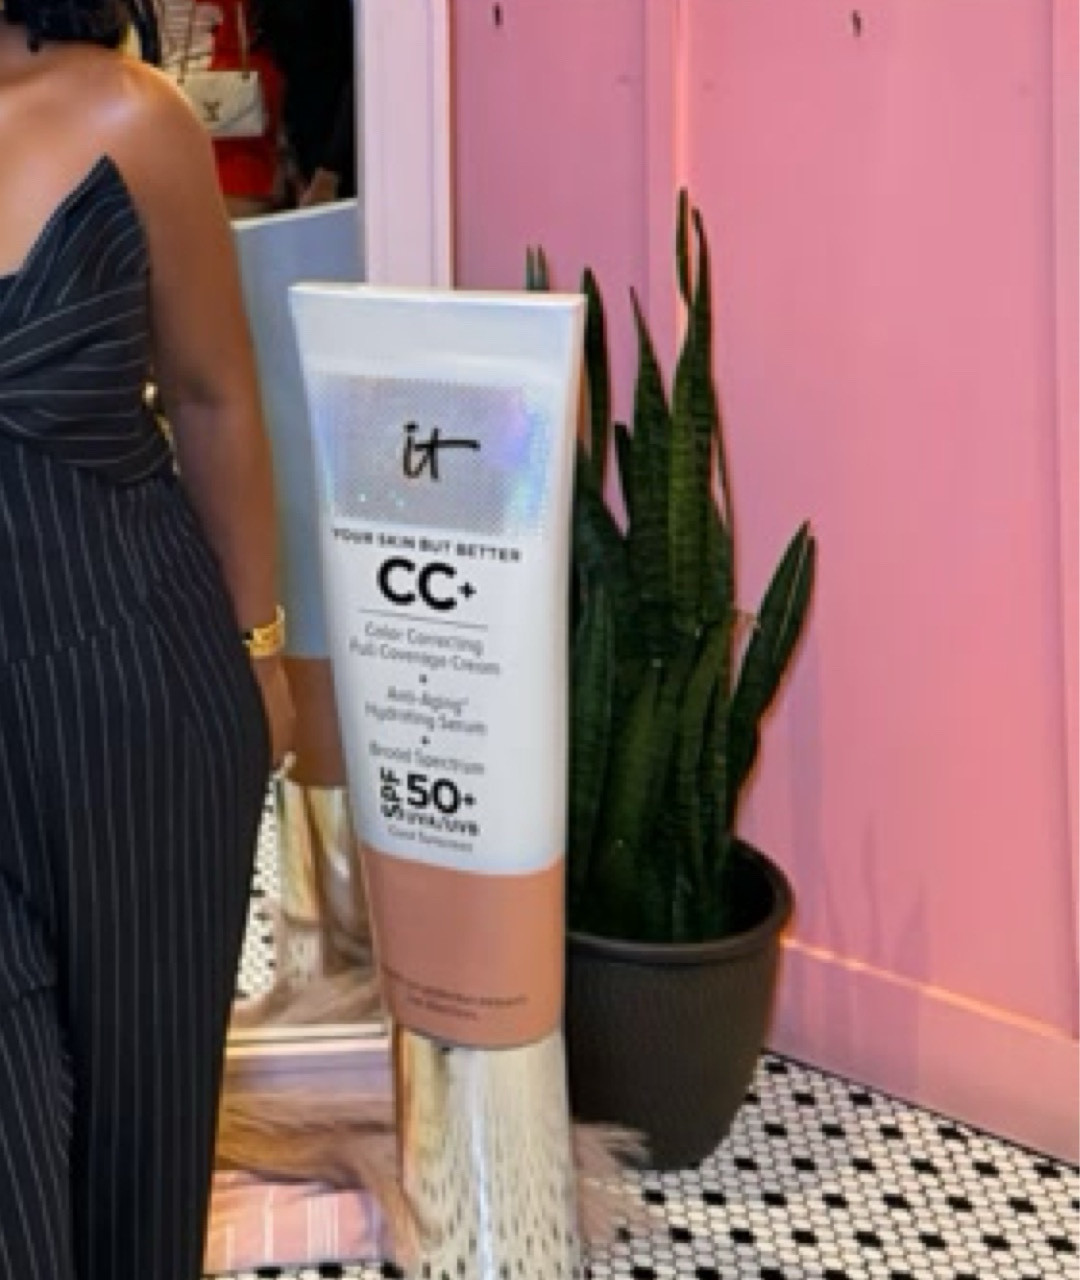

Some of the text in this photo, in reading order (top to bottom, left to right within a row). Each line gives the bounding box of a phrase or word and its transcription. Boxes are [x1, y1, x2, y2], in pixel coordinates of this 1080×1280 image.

[402, 420, 481, 483] it
[332, 527, 522, 562] YOUR SKIN BUT BETTER
[376, 555, 478, 611] CC+
[406, 772, 477, 815] 50+
